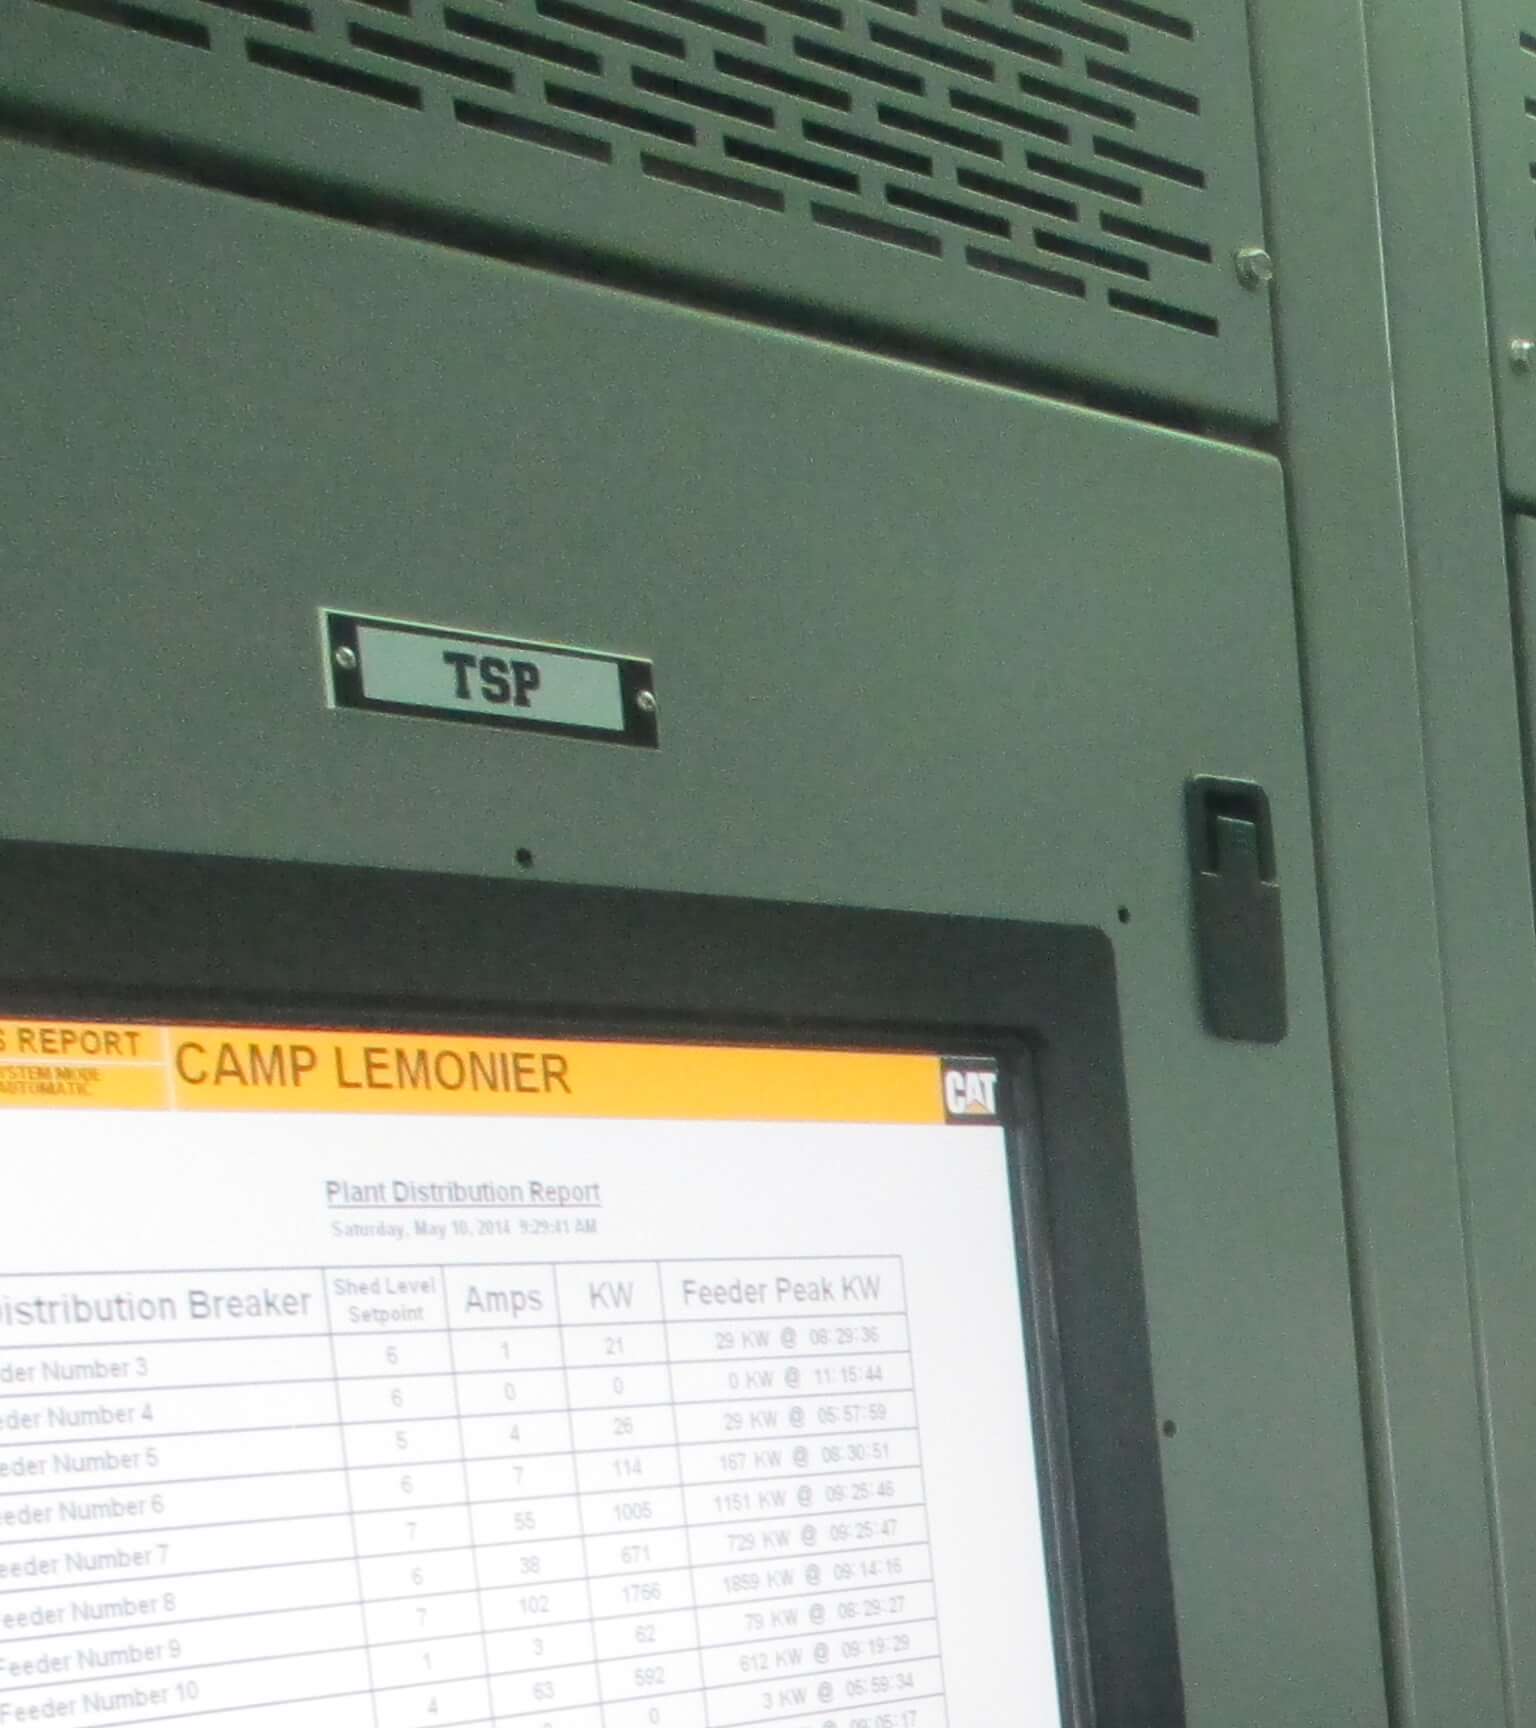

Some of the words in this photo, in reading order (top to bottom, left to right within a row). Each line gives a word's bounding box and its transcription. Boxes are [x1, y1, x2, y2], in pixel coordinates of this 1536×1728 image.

[443, 650, 541, 707] TSP
[17, 1027, 141, 1056] REPORT
[176, 1041, 317, 1087] CAMP
[334, 1045, 573, 1094] LEMONIER
[944, 1070, 997, 1115] CAT
[325, 1180, 387, 1204] Plant
[392, 1179, 523, 1204] Distribution
[529, 1180, 601, 1207] Report
[414, 1219, 447, 1239] May
[575, 1216, 598, 1233] AM
[334, 1278, 381, 1296] Shed
[385, 1276, 437, 1295] Level
[590, 1281, 634, 1310] KW
[682, 1277, 767, 1305] Feeder
[776, 1275, 836, 1304] Peak
[842, 1275, 881, 1301] KW
[0, 1293, 177, 1328] istribution
[188, 1288, 313, 1321] Breaker
[464, 1286, 544, 1318] Amps
[349, 1305, 425, 1326] Setpoint
[604, 1337, 625, 1356] 21
[741, 1329, 770, 1348] KW
[42, 1359, 129, 1382] Number
[136, 1357, 149, 1377] 3
[745, 1369, 774, 1389] KW
[390, 1388, 404, 1408] 6
[504, 1381, 517, 1402] 0
[48, 1404, 135, 1428] Number
[141, 1402, 154, 1422] 4
[749, 1410, 779, 1429] KW
[509, 1423, 521, 1442] 4
[53, 1450, 141, 1473] Number
[145, 1447, 160, 1468] 5
[612, 1458, 644, 1478] 114
[753, 1450, 782, 1470] KW
[400, 1474, 414, 1495] 6
[513, 1466, 525, 1485] 7
[58, 1496, 146, 1521] Number
[151, 1493, 165, 1514] 6
[757, 1489, 787, 1510] KW
[406, 1521, 417, 1541] 7
[513, 1511, 537, 1531] 55
[762, 1530, 791, 1550] KW
[64, 1549, 153, 1571] Number
[155, 1543, 169, 1565] 7
[410, 1566, 425, 1586] 6
[766, 1568, 795, 1588] KW
[71, 1596, 157, 1622] Number
[163, 1592, 177, 1612] 8
[519, 1594, 551, 1614] 102
[770, 1608, 798, 1629] KW
[76, 1644, 165, 1672] Number
[168, 1638, 182, 1660] 9
[532, 1637, 545, 1656] 3
[775, 1648, 803, 1668] KW
[532, 1680, 556, 1702] 63
[778, 1688, 807, 1708] KW
[0, 1700, 76, 1725] Feeder
[82, 1689, 169, 1715] Number
[176, 1680, 200, 1702] 10
[427, 1696, 439, 1715] 4
